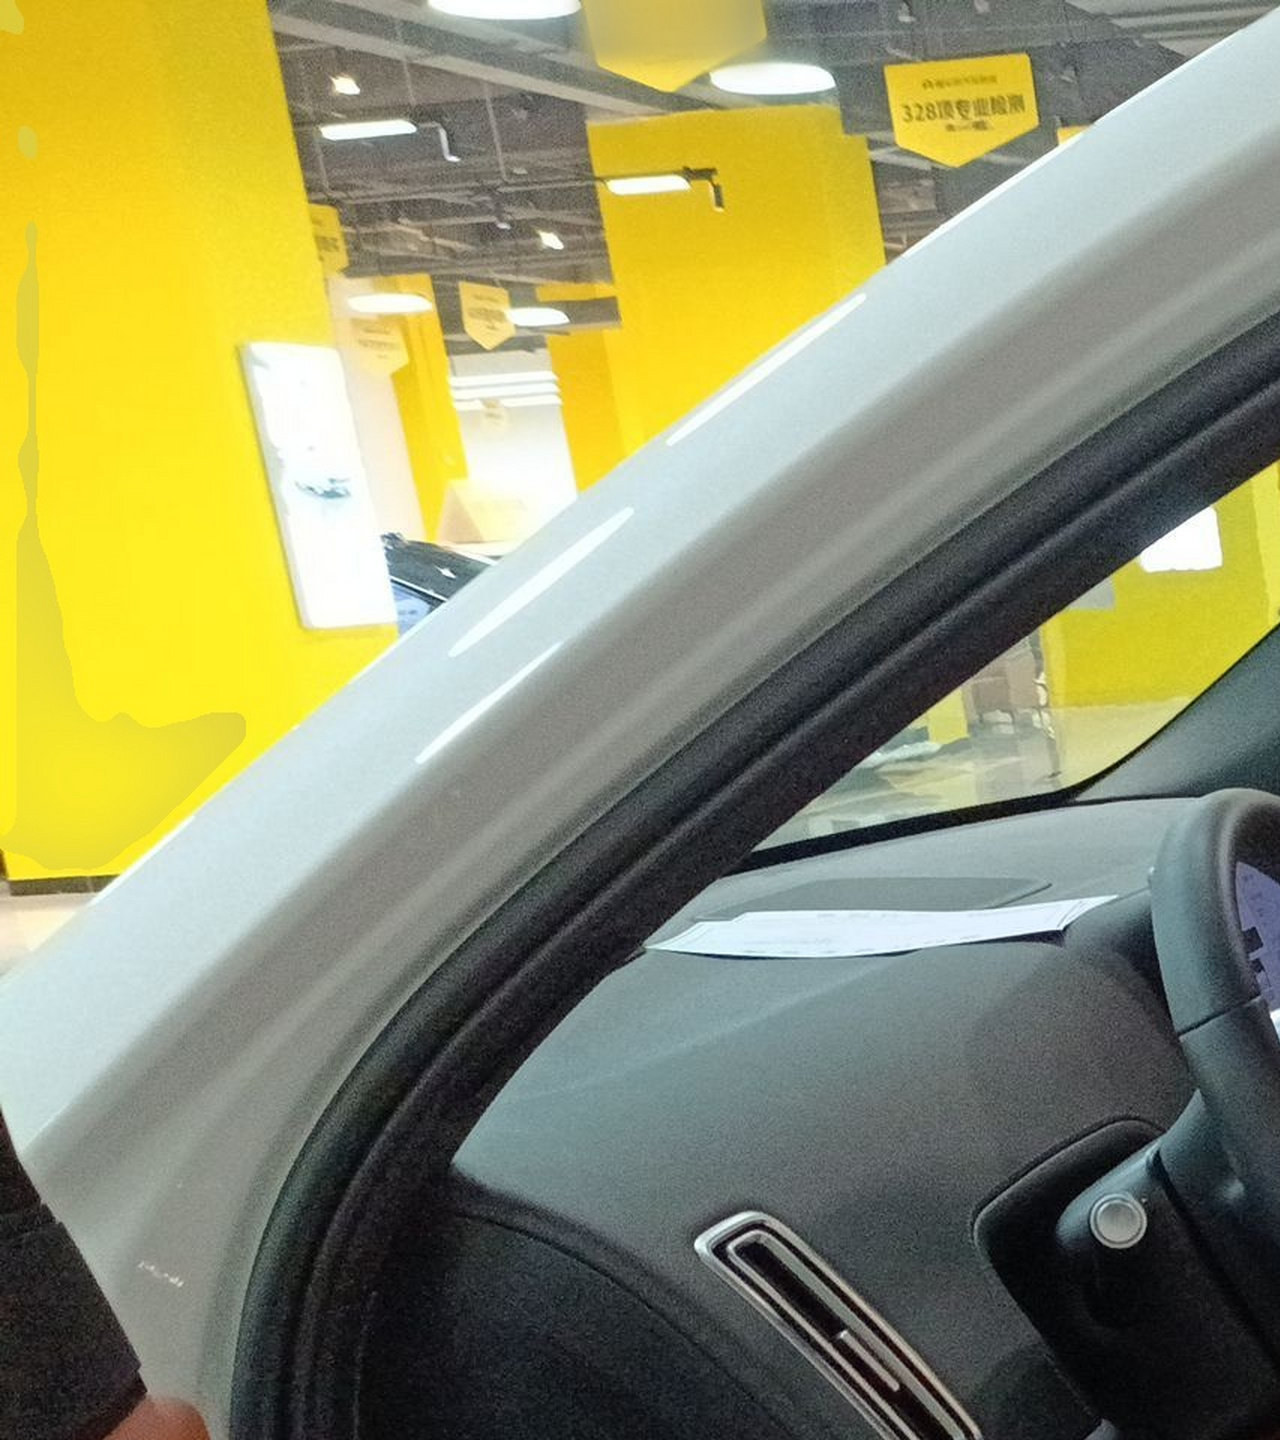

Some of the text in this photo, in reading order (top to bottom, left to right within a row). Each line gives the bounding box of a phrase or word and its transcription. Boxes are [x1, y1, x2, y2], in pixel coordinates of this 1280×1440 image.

[902, 94, 1025, 121] 328项专业检测
